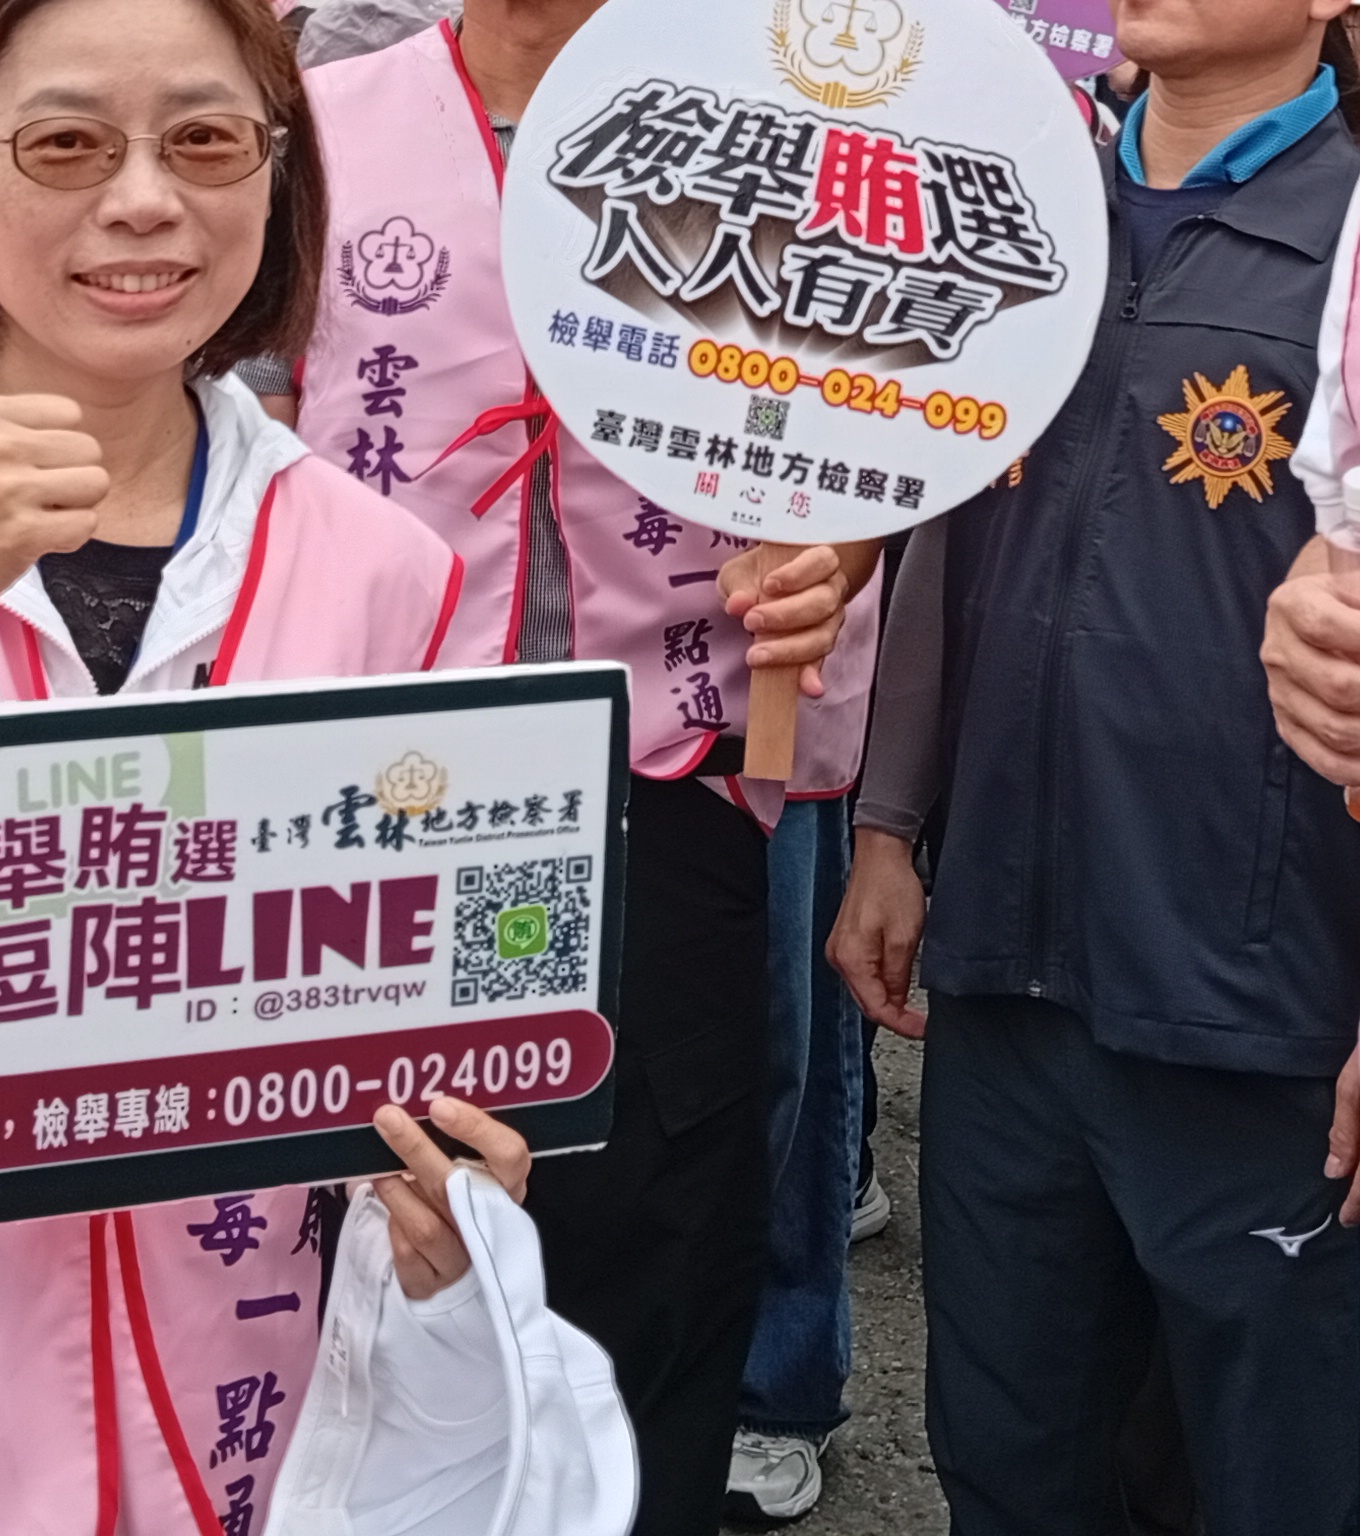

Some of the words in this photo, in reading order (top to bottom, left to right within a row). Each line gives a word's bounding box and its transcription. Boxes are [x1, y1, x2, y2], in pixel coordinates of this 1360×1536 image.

[552, 84, 1064, 288] 檢舉賄選
[588, 206, 998, 359] 人人有責
[347, 344, 420, 497] 雲林
[547, 309, 681, 370] 檢舉電話
[687, 338, 1008, 441] 0800-024-099
[591, 408, 926, 511] 臺灣雲林地方檢察署
[693, 471, 812, 519] 關心您
[663, 569, 731, 731] 一點通
[16, 750, 141, 814] LINE
[251, 785, 584, 852] 臺灣雲林地方檢察署
[253, 980, 427, 1021] @383trvqw
